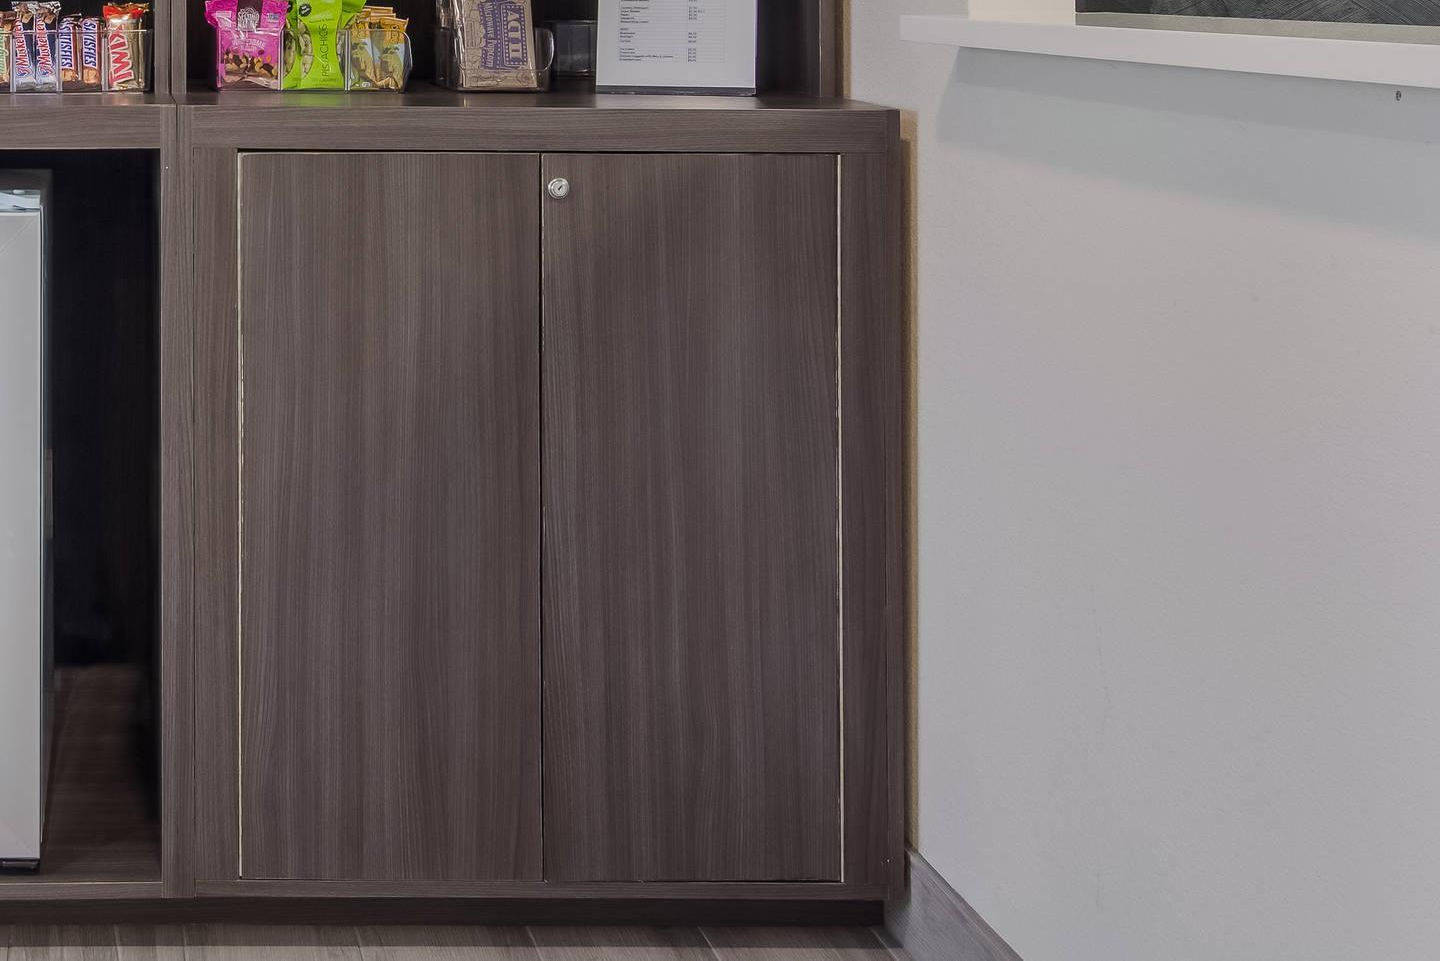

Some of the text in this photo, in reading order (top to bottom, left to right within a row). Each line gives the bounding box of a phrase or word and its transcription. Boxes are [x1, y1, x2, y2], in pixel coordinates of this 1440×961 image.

[483, 2, 498, 68] Microwave Popcorn
[506, 10, 521, 39] ACT
